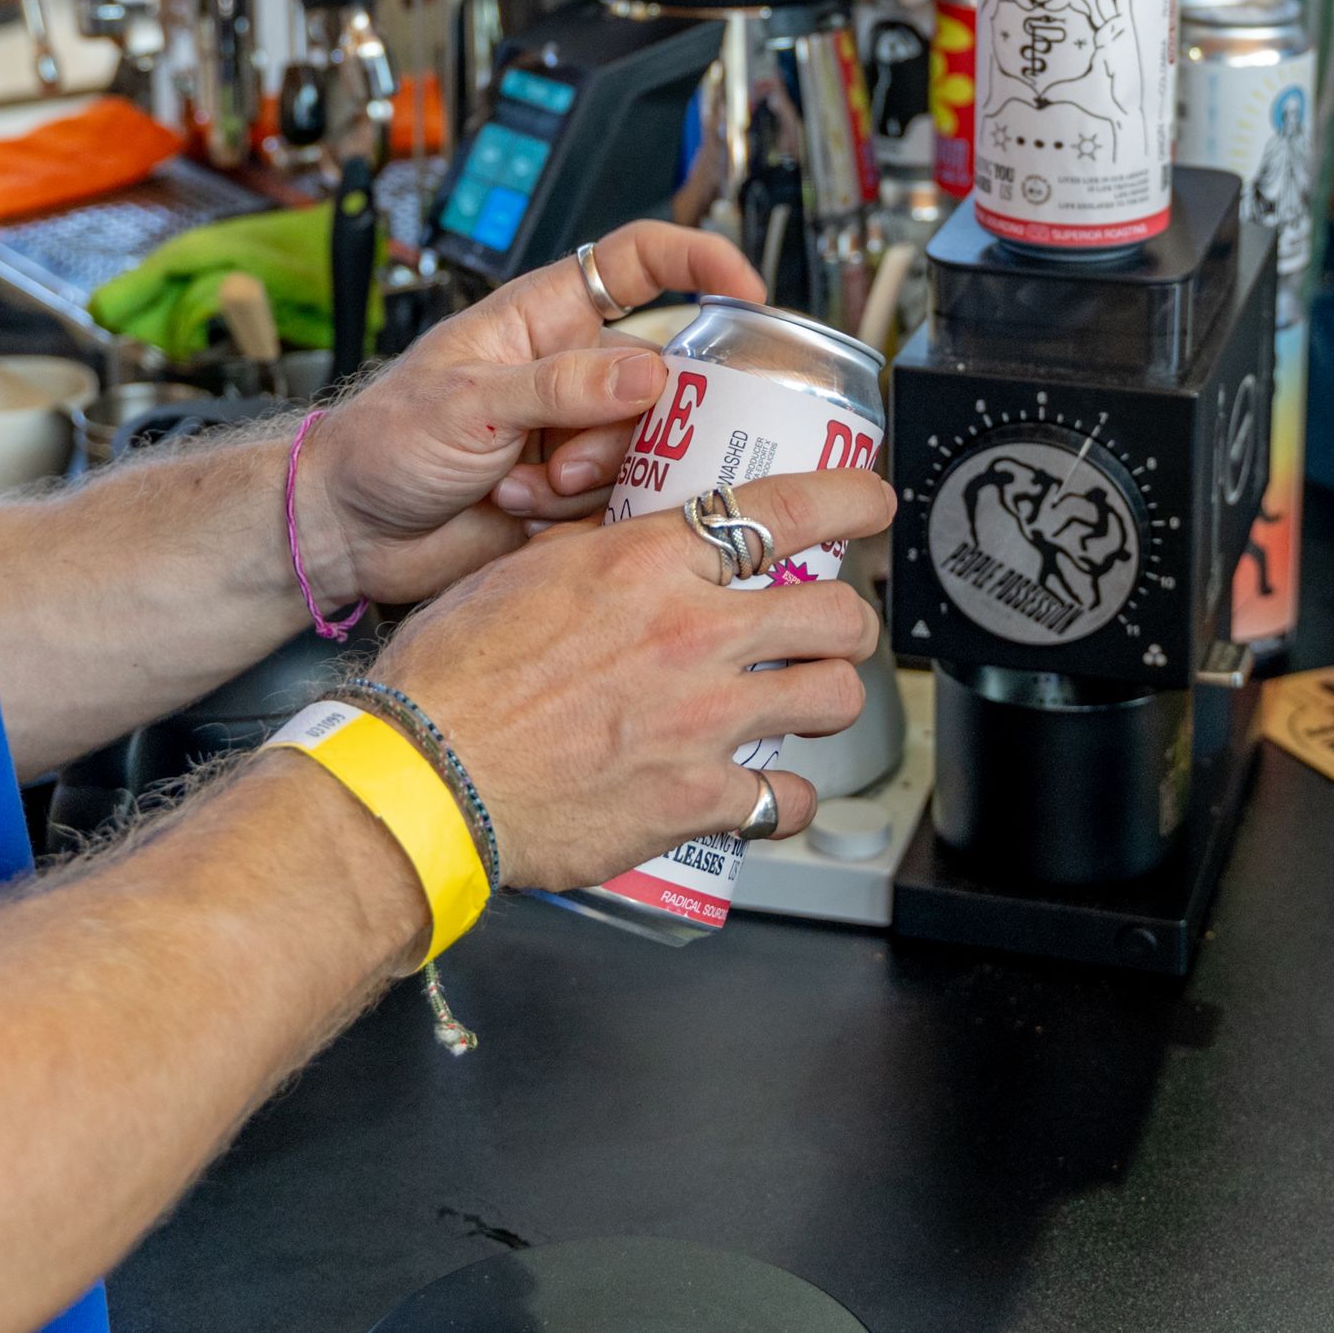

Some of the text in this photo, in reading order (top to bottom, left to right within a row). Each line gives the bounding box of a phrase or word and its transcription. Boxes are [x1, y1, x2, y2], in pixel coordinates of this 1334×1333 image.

[718, 430, 748, 488] WASHED
[746, 437, 764, 480] PRODUCER
[763, 442, 778, 478] RODUCERS
[941, 543, 1085, 635] PEOPLE POSSESSION
[663, 844, 725, 875] LEASES
[661, 891, 701, 913] RADICAL
